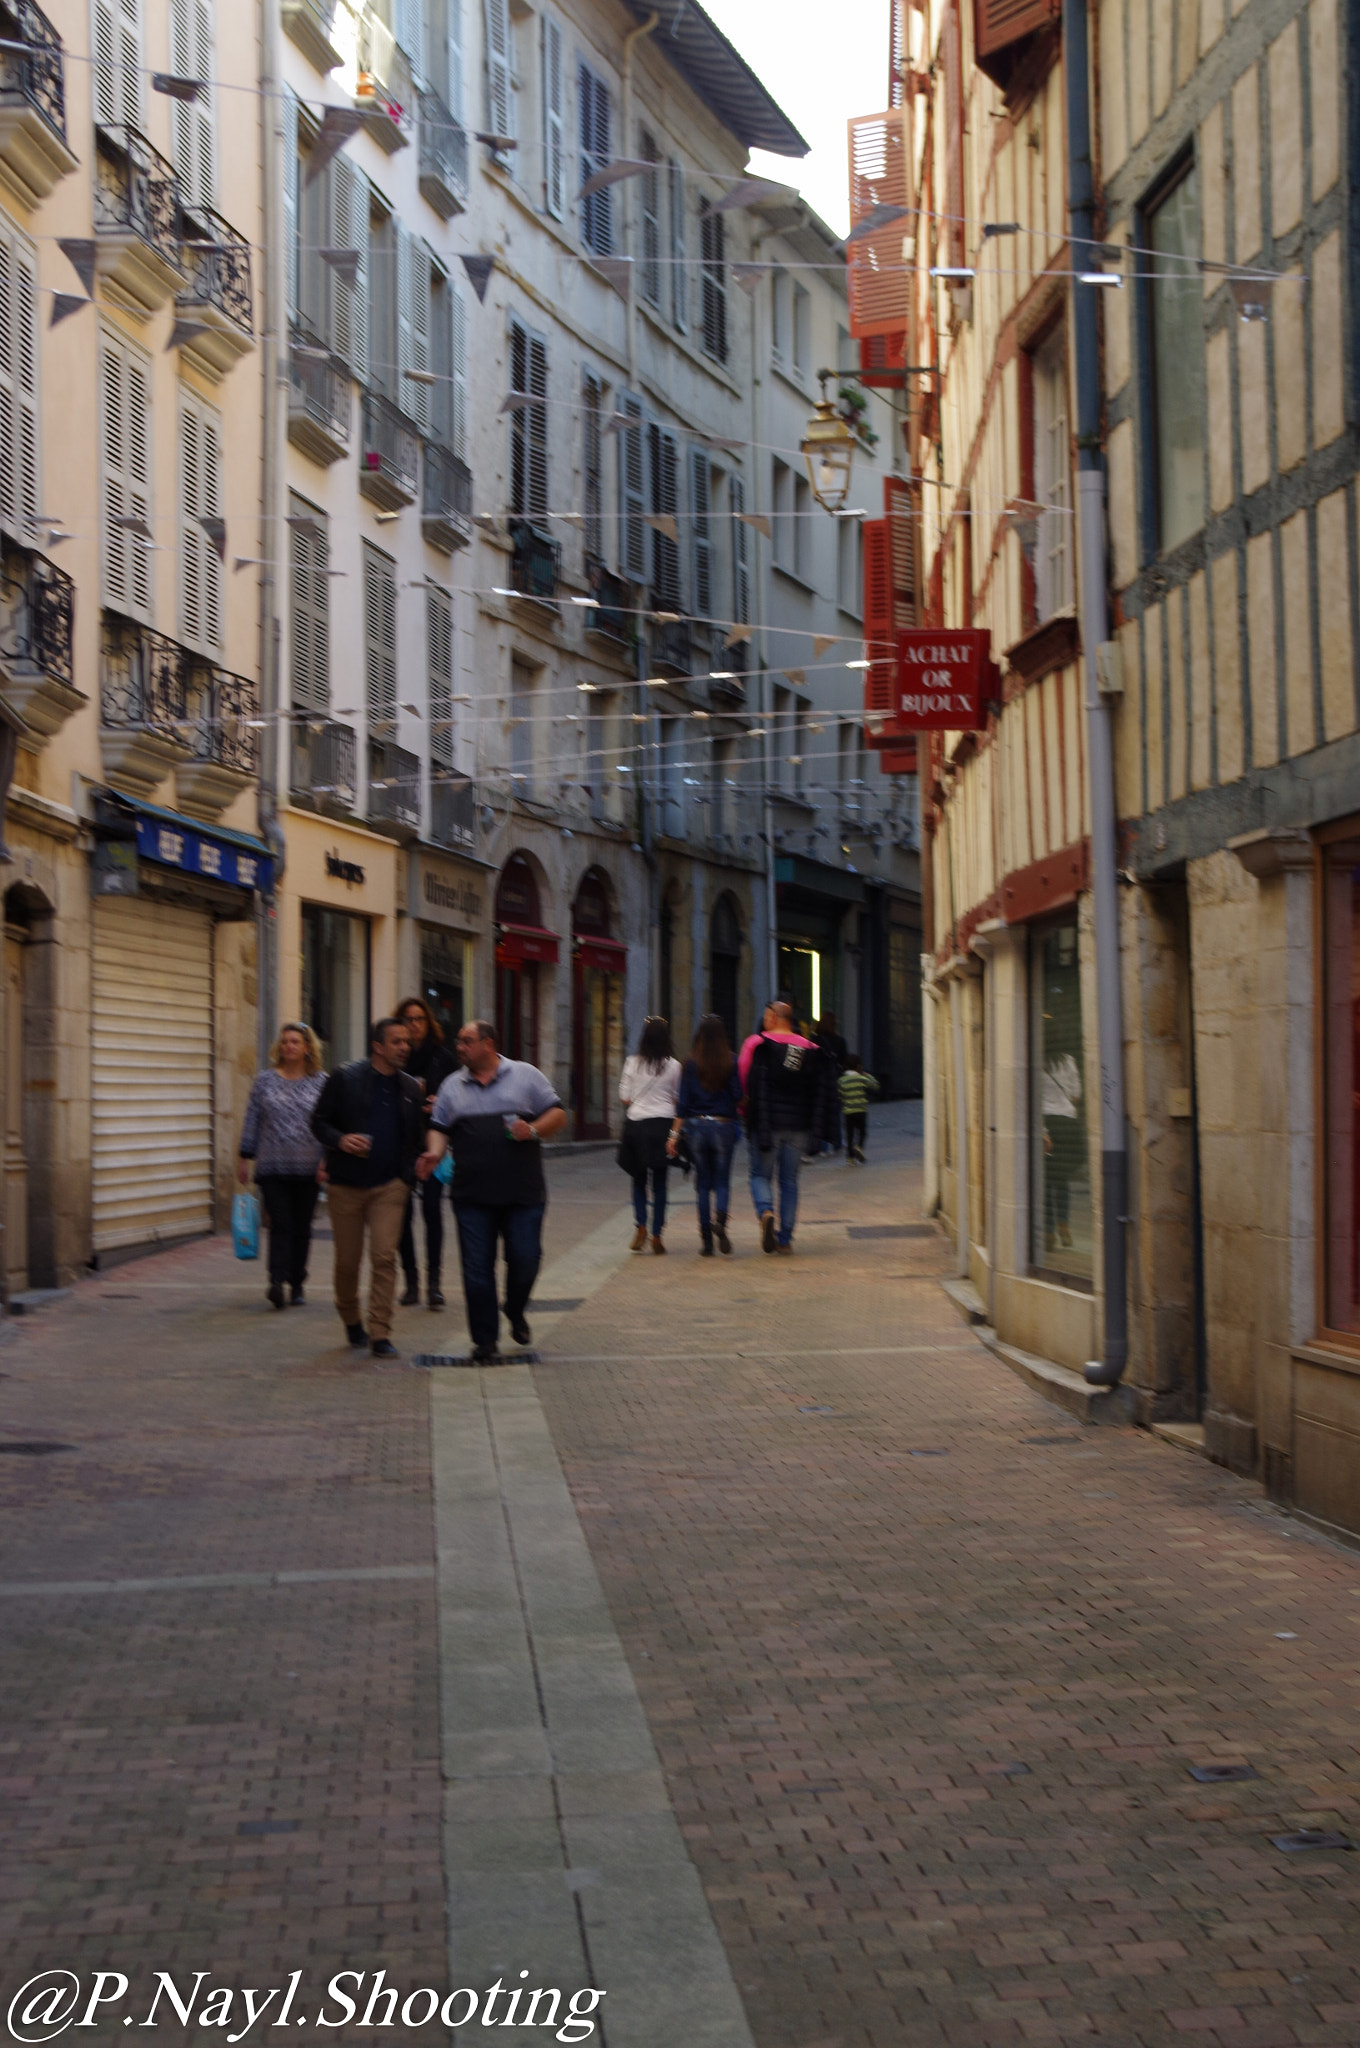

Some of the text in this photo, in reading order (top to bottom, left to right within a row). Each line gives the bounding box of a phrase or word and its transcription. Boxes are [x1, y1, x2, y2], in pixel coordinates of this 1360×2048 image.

[904, 645, 973, 663] ACHAT
[922, 669, 952, 688] OR
[901, 694, 973, 716] BIJOUX
